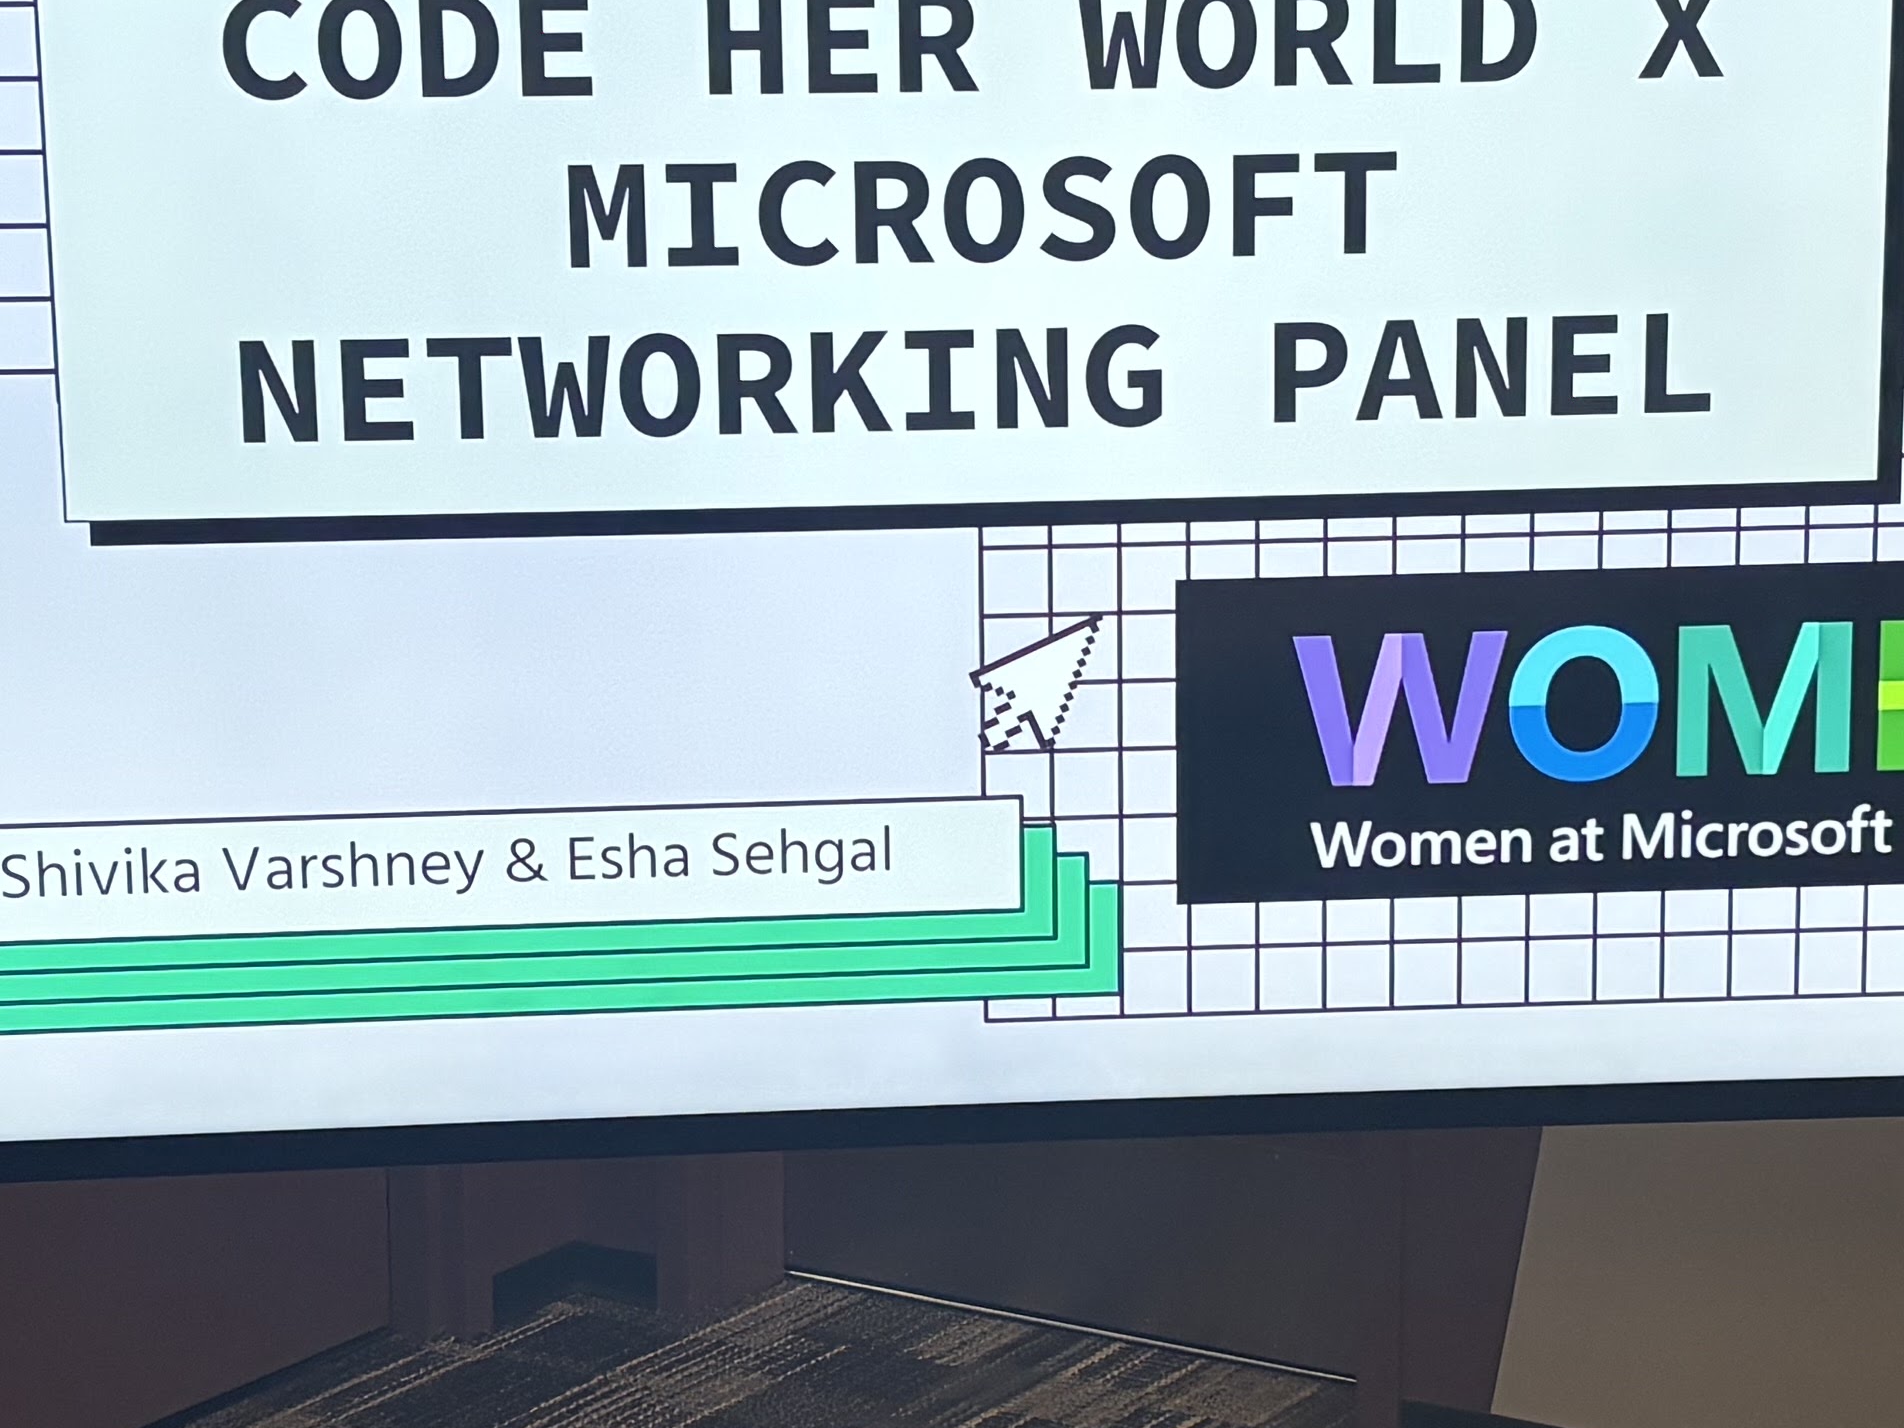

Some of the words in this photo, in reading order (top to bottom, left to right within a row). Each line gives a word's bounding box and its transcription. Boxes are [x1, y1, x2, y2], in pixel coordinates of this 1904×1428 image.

[567, 150, 1398, 269] MICROSOFT
[238, 323, 1163, 444] NETWORKING
[1273, 312, 1711, 423] PANEL
[1, 847, 200, 899] Shivika
[222, 840, 484, 895] Varshney
[506, 837, 548, 883] &
[569, 832, 689, 880] Esha
[712, 824, 892, 885] Sehgal
[1309, 820, 1533, 869] Women
[1549, 817, 1605, 863] at
[1622, 803, 1893, 860] Microsoft
